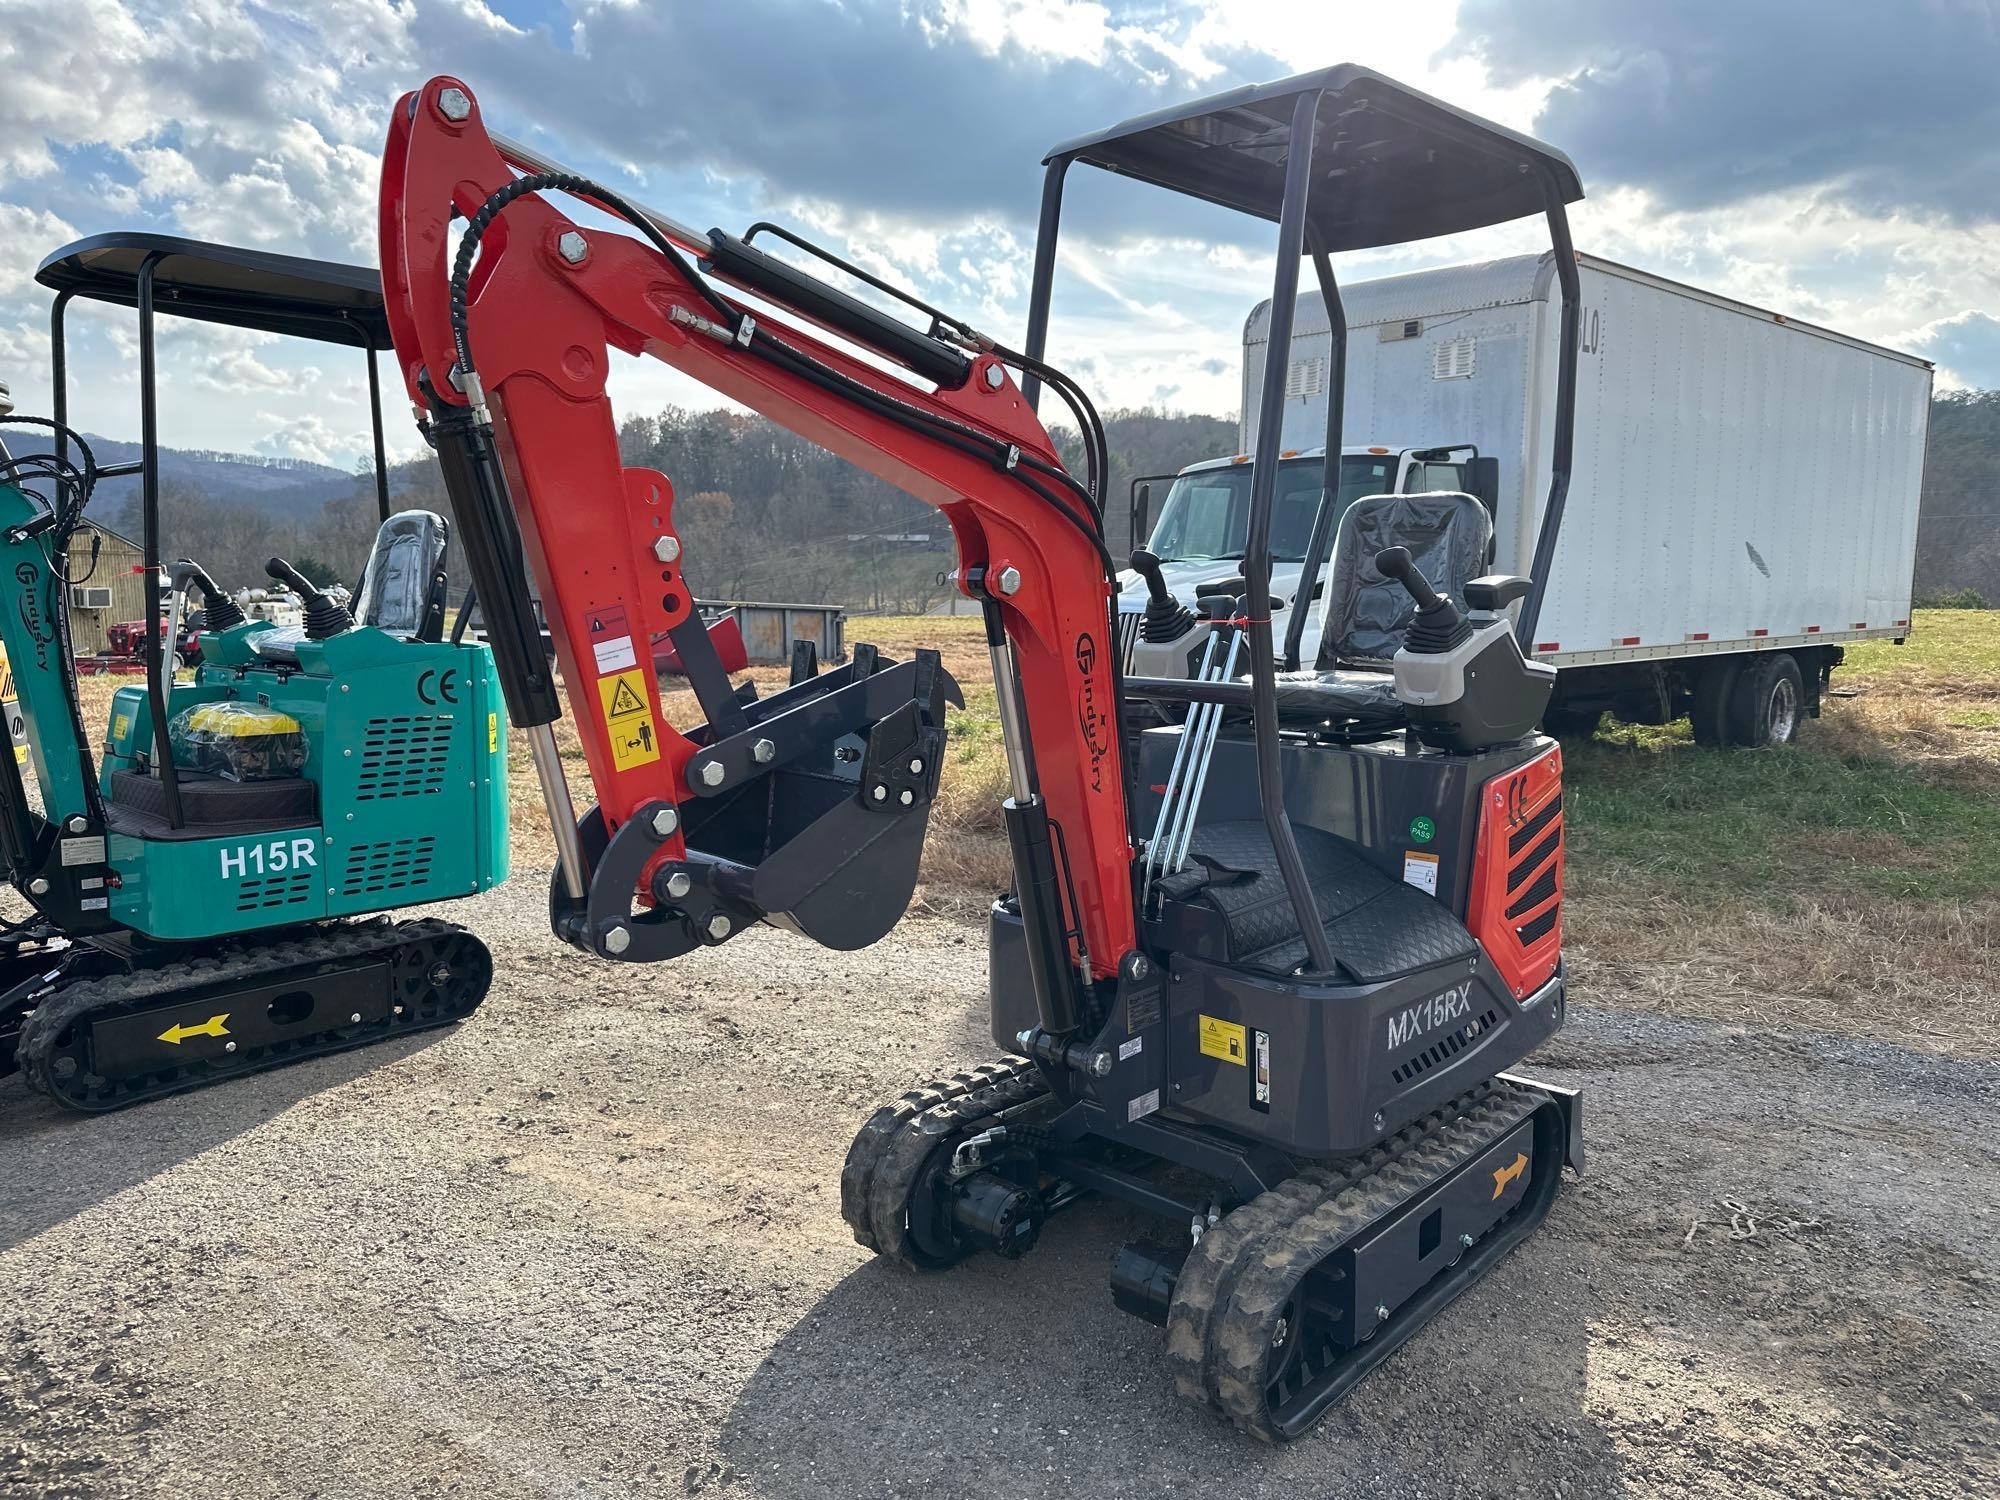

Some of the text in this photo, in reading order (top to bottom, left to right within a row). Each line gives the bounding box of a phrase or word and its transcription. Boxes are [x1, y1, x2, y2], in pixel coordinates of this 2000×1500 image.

[417, 668, 459, 706] CE
[1411, 827, 1431, 839] PASS
[1417, 821, 1429, 830] QC
[220, 837, 318, 879] H15R
[1387, 979, 1472, 1051] MX15RX
